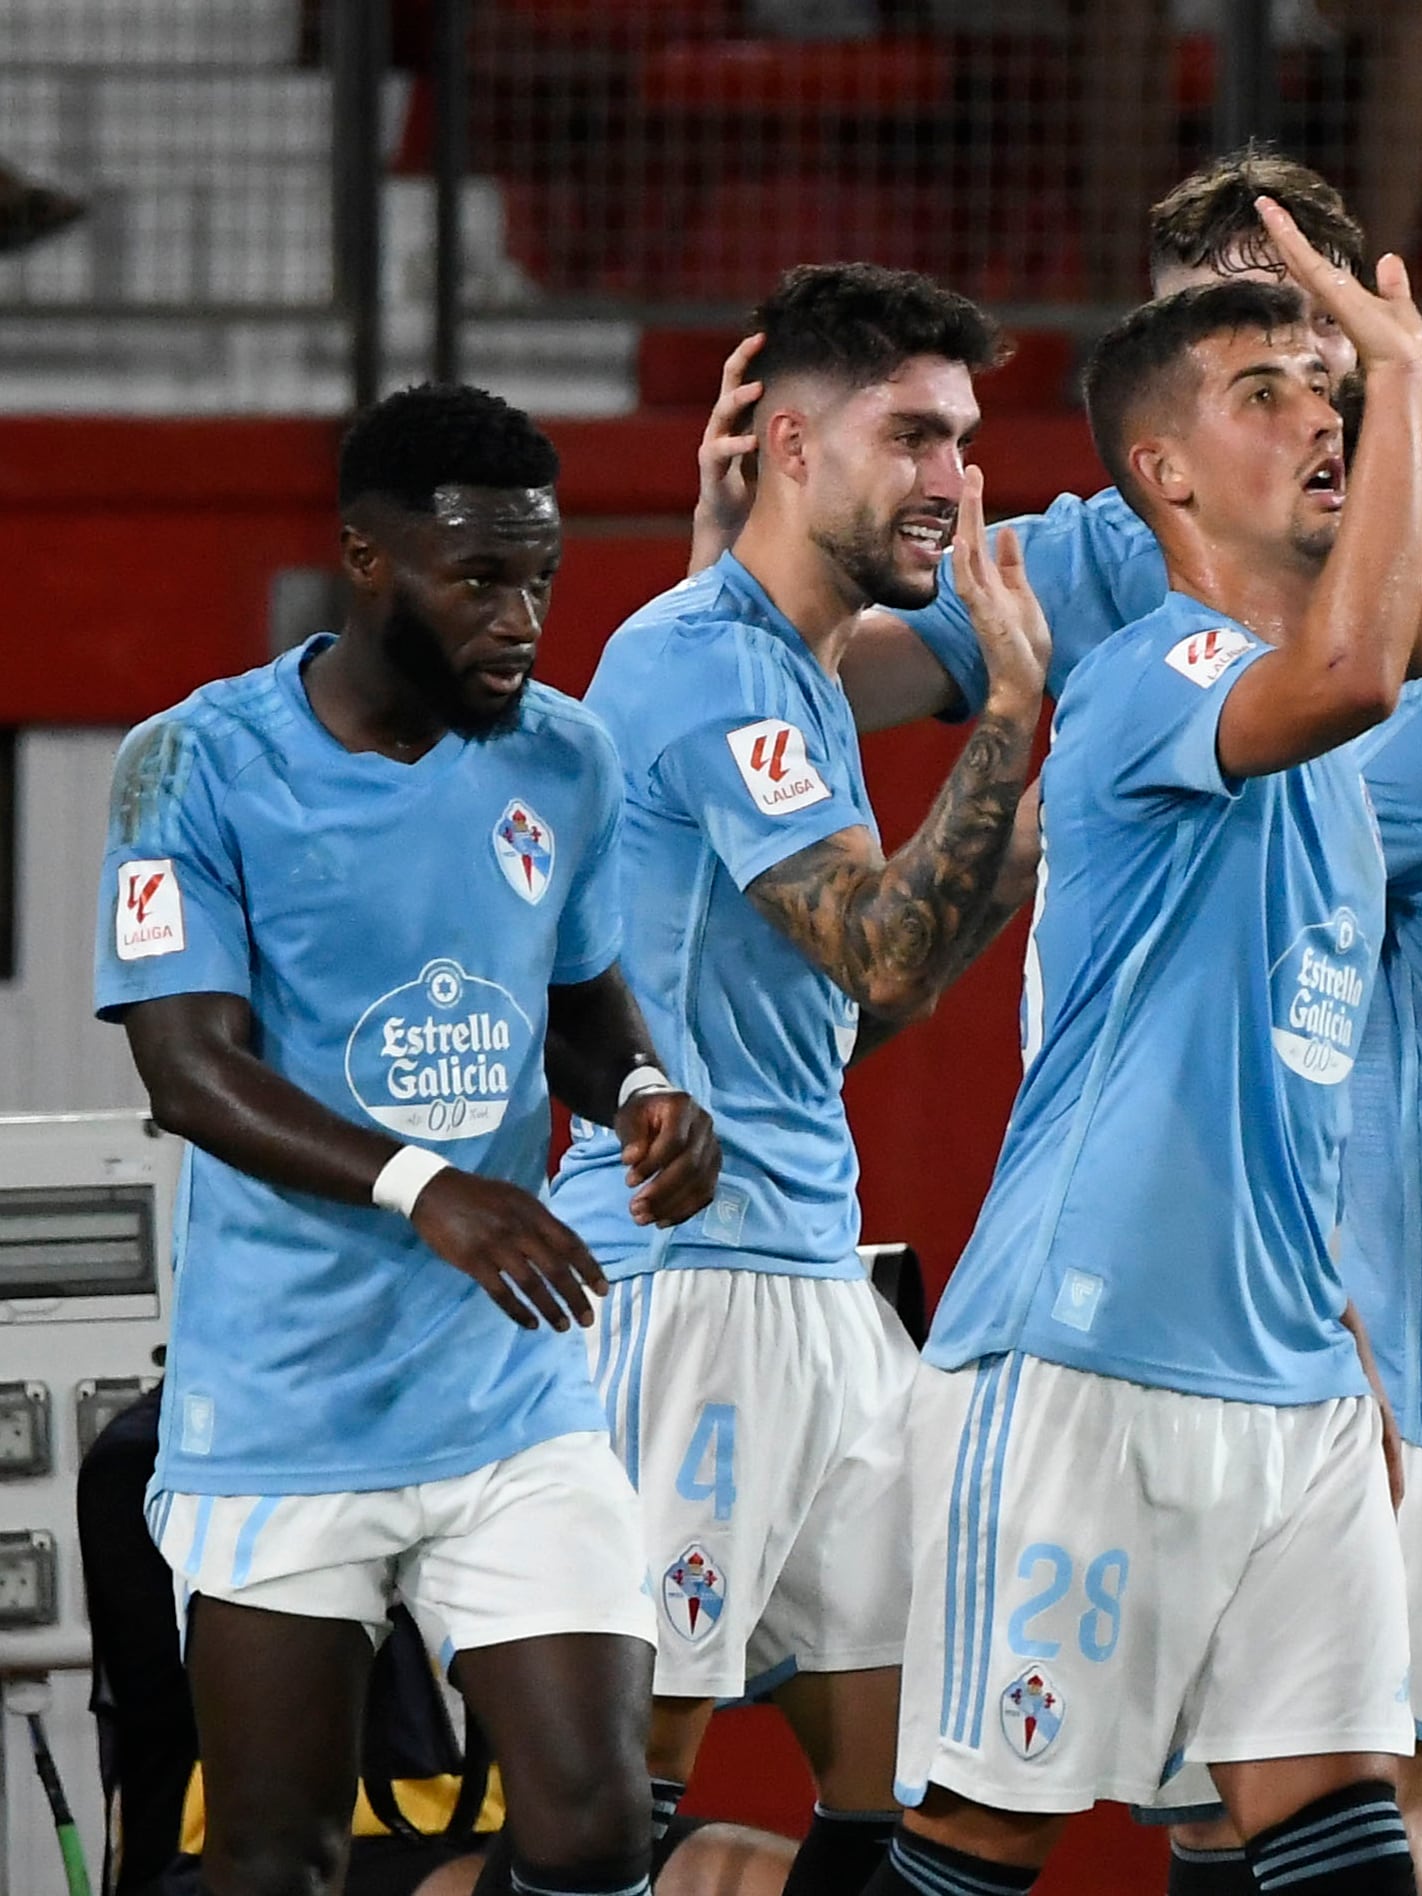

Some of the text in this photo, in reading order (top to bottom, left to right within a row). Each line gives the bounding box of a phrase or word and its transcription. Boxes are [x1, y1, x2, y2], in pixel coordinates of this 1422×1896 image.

[762, 778, 815, 805] LALIGA
[123, 924, 174, 946] LALIGA
[1296, 947, 1364, 1008] Estrella
[380, 1012, 511, 1058] Estrella
[1288, 987, 1354, 1048] Galicia
[386, 1053, 510, 1100] Galicia
[674, 1401, 738, 1521] 4
[1007, 1542, 1130, 1664] 28
